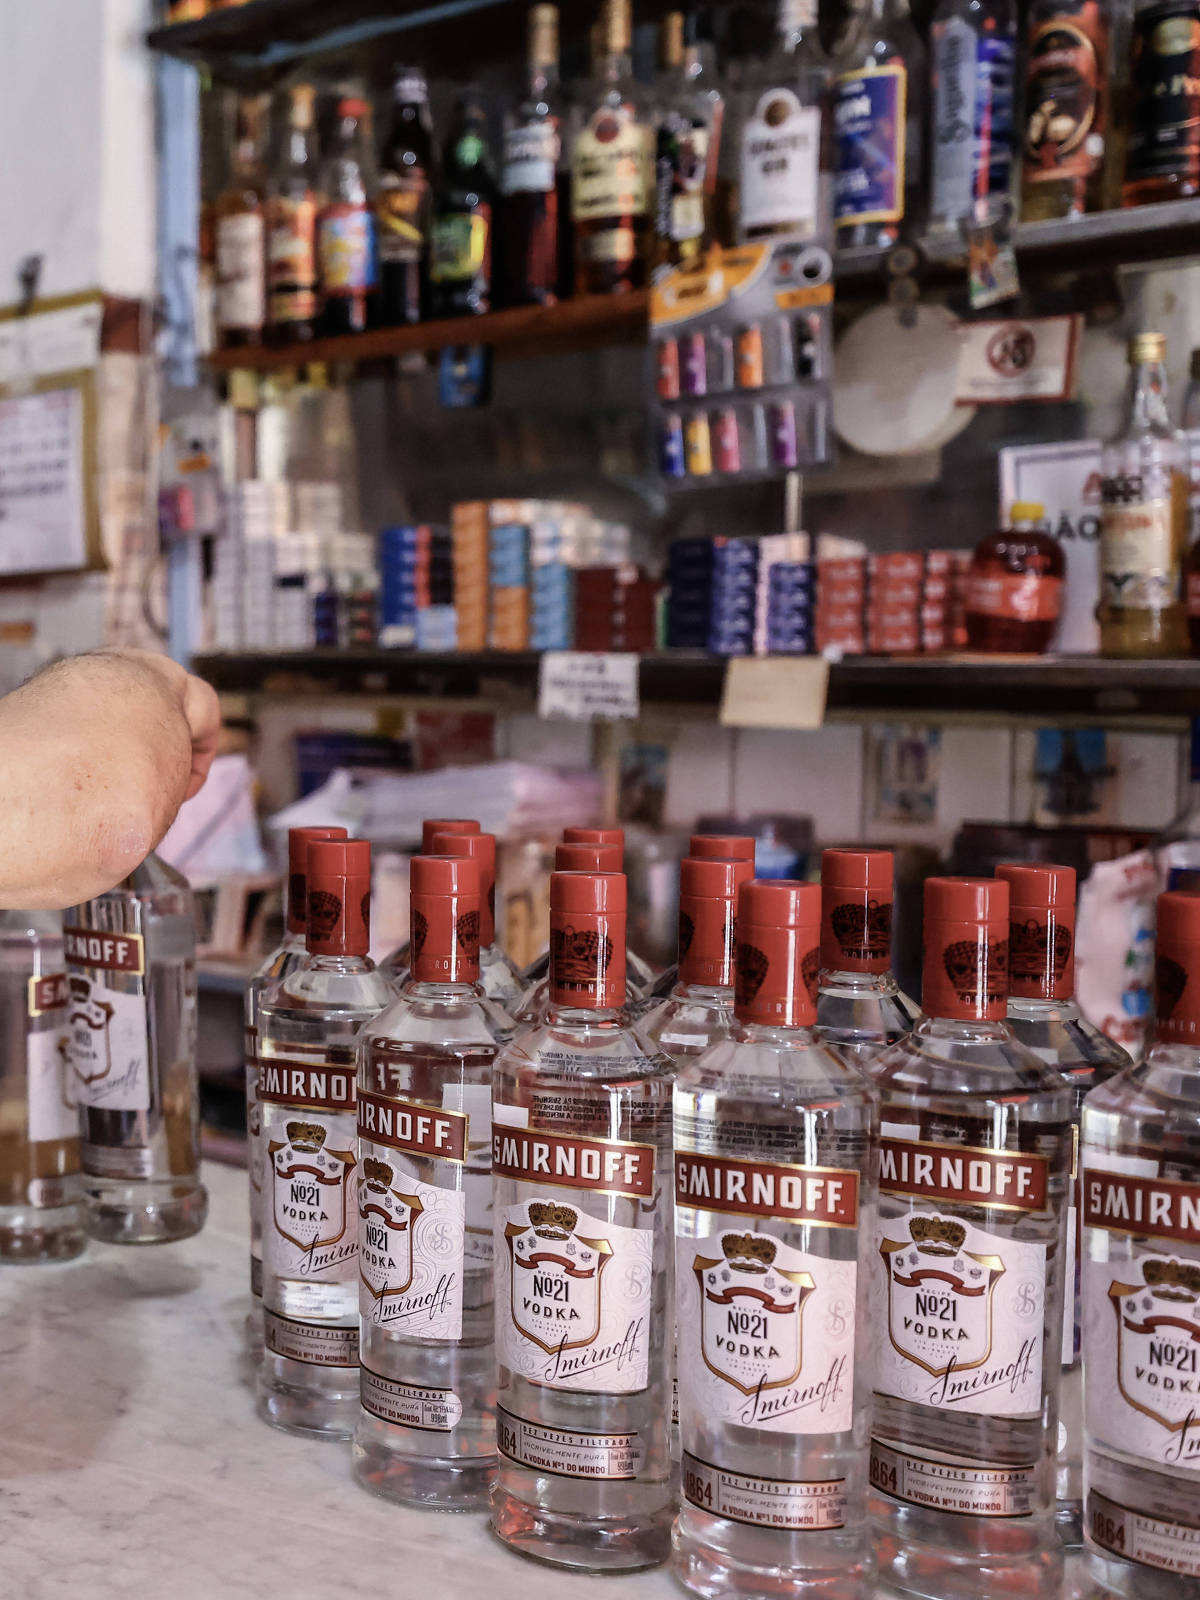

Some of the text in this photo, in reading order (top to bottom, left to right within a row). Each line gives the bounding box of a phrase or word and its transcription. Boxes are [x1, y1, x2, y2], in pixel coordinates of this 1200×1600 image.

[260, 1065, 357, 1102] SMIRNO
[493, 1135, 640, 1185] SMIRNOFF
[678, 1162, 843, 1213] SMIRNOFF
[283, 1203, 329, 1221] VODKA
[1090, 1181, 1200, 1230] SMIRN
[299, 1233, 359, 1275] Smirn
[362, 1245, 396, 1268] VODKA
[538, 1270, 564, 1279] RECIPE
[373, 1272, 456, 1324] Smirnoff
[523, 1297, 580, 1320] VODKA
[904, 1316, 969, 1340] VODKA
[545, 1317, 643, 1382] Smirnoff
[716, 1334, 780, 1359] VODKA
[930, 1336, 1037, 1405] Smirnoff
[1135, 1366, 1200, 1394] VODK
[398, 1387, 443, 1400] FILTRADA
[741, 1354, 847, 1425] Smirnoff
[388, 1409, 396, 1418] DO
[397, 1412, 420, 1423] MUNDO
[529, 1455, 551, 1468] VODKA
[567, 1463, 577, 1473] DO
[578, 1465, 605, 1474] MUNDO
[914, 1491, 940, 1505] VODKA
[972, 1501, 1001, 1511] MUNDO
[729, 1505, 754, 1519] VODKA
[773, 1515, 784, 1524] DO
[785, 1517, 814, 1525] MUNDO
